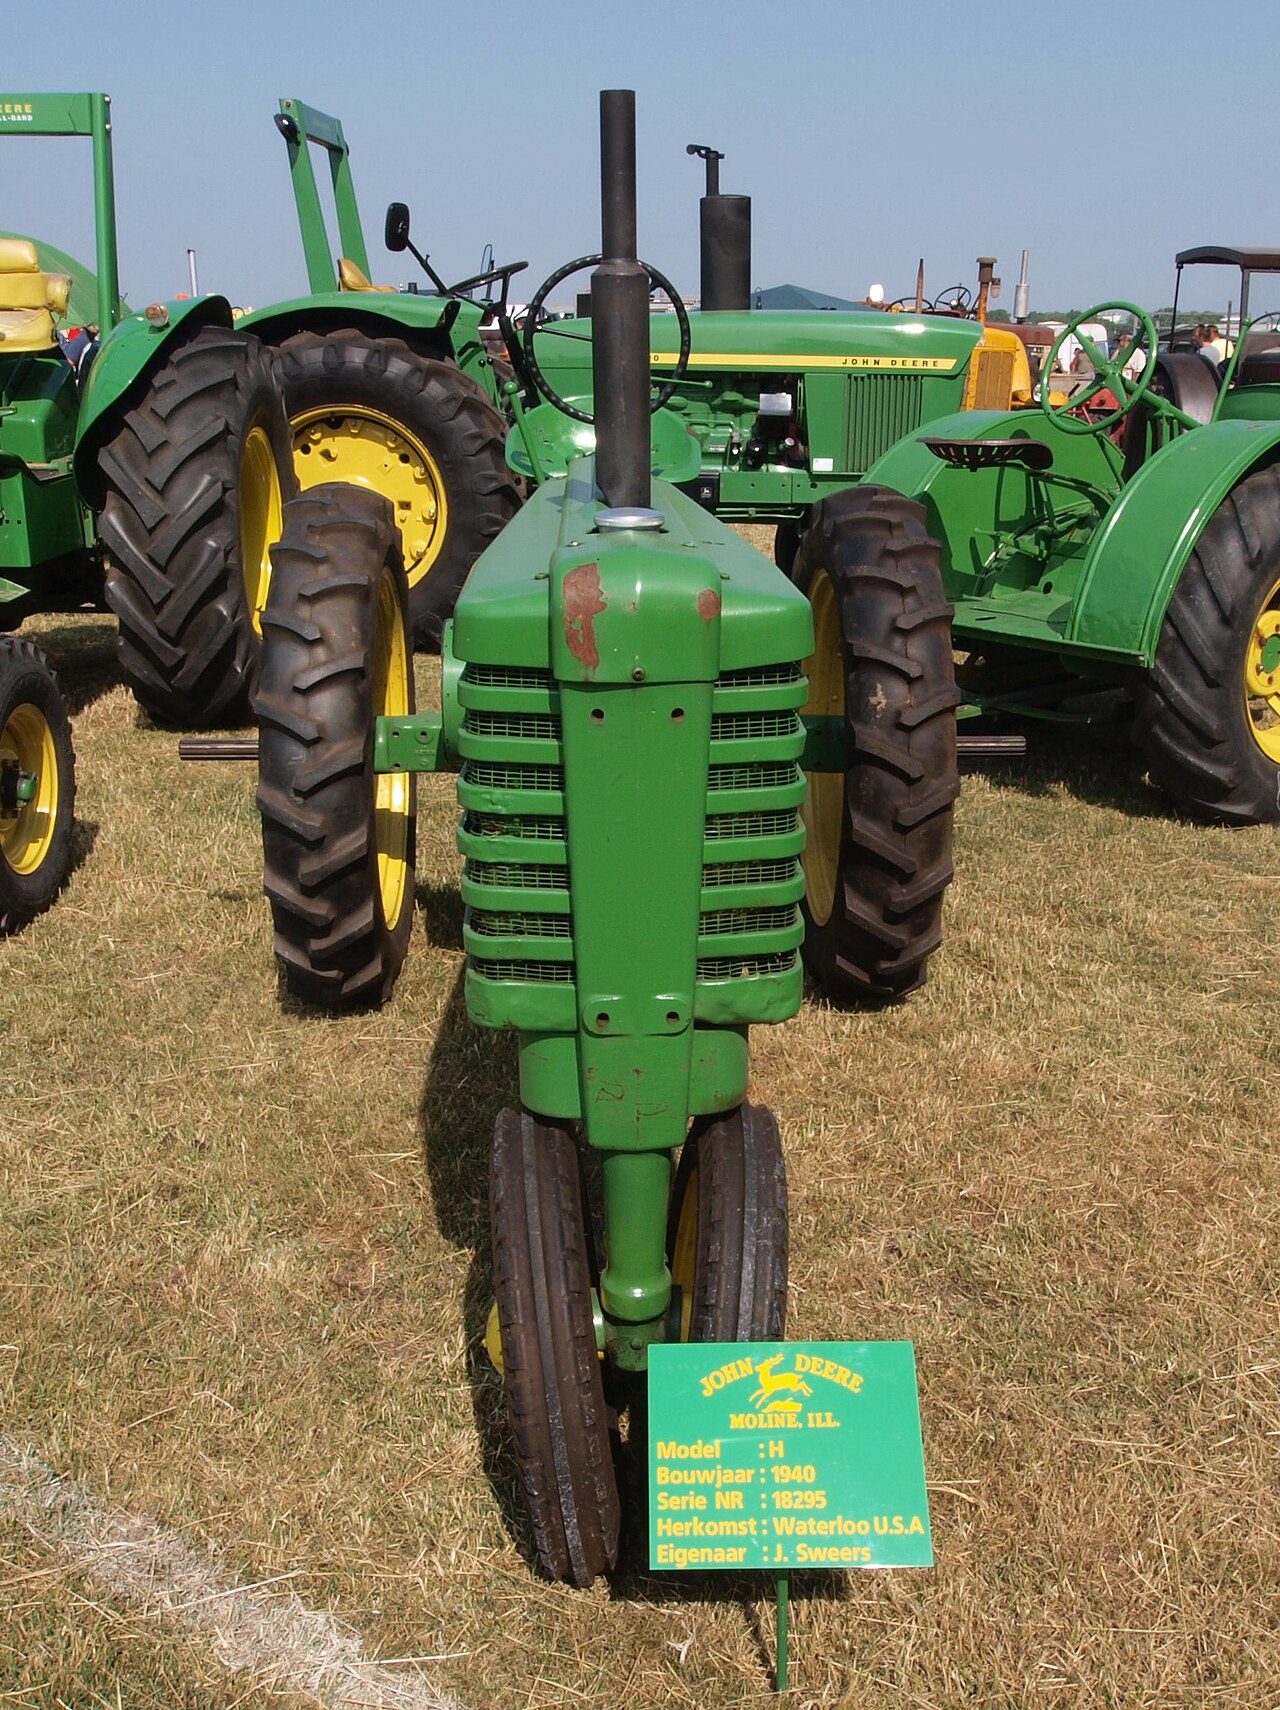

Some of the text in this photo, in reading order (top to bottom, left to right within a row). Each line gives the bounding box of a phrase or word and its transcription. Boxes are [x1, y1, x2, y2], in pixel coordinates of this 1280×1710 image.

[700, 1353, 864, 1397] JOHN DEERE
[807, 1411, 841, 1428] ILL.
[656, 1440, 721, 1460] Model
[656, 1465, 755, 1488] Bouwjaar
[770, 1465, 817, 1484] 1940
[657, 1491, 707, 1511] Serie
[714, 1491, 745, 1510] NR
[771, 1490, 828, 1510] 18295
[656, 1516, 758, 1537] Herkomst
[772, 1515, 870, 1536] Waterloo
[873, 1516, 926, 1535] U.S.A
[656, 1543, 748, 1568] Eigenaar
[773, 1544, 789, 1563] J.
[796, 1542, 872, 1563] Sweers
